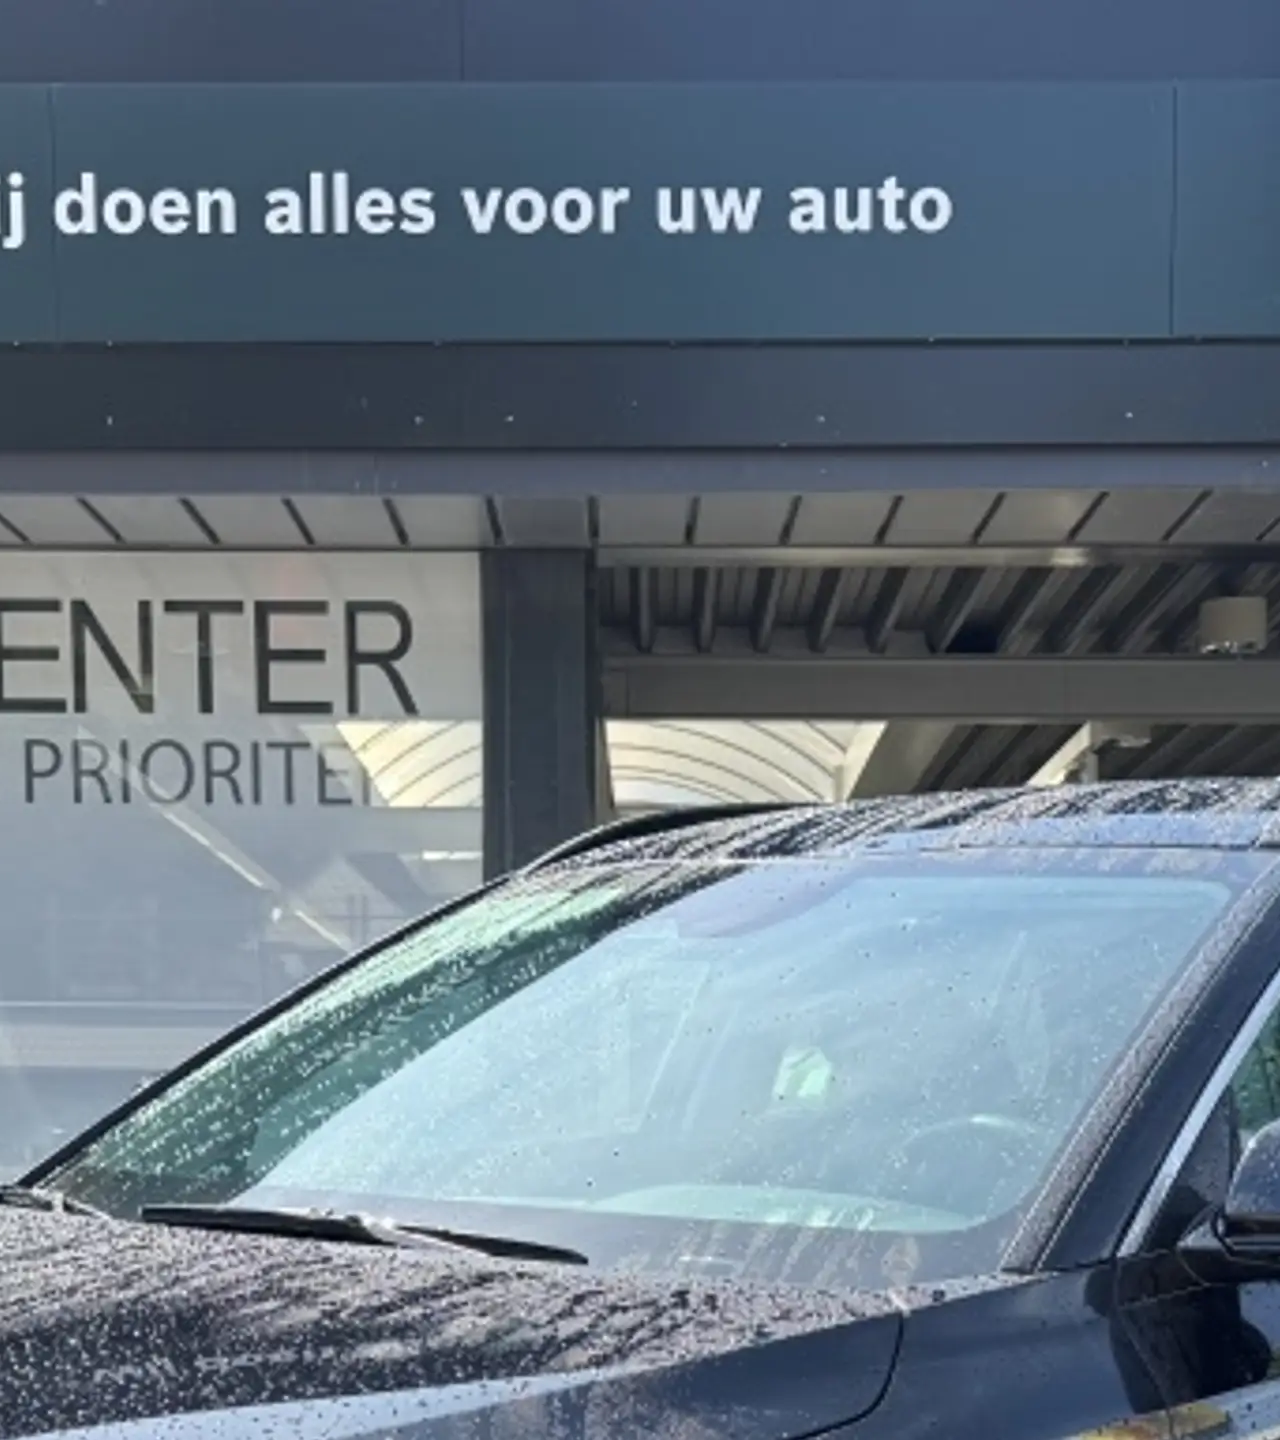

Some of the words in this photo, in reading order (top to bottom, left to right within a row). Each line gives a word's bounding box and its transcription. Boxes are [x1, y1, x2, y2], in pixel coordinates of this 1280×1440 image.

[53, 171, 238, 235] doen
[264, 170, 437, 235] alles
[460, 186, 631, 235] voor
[656, 186, 763, 235] uw
[787, 175, 955, 235] auto
